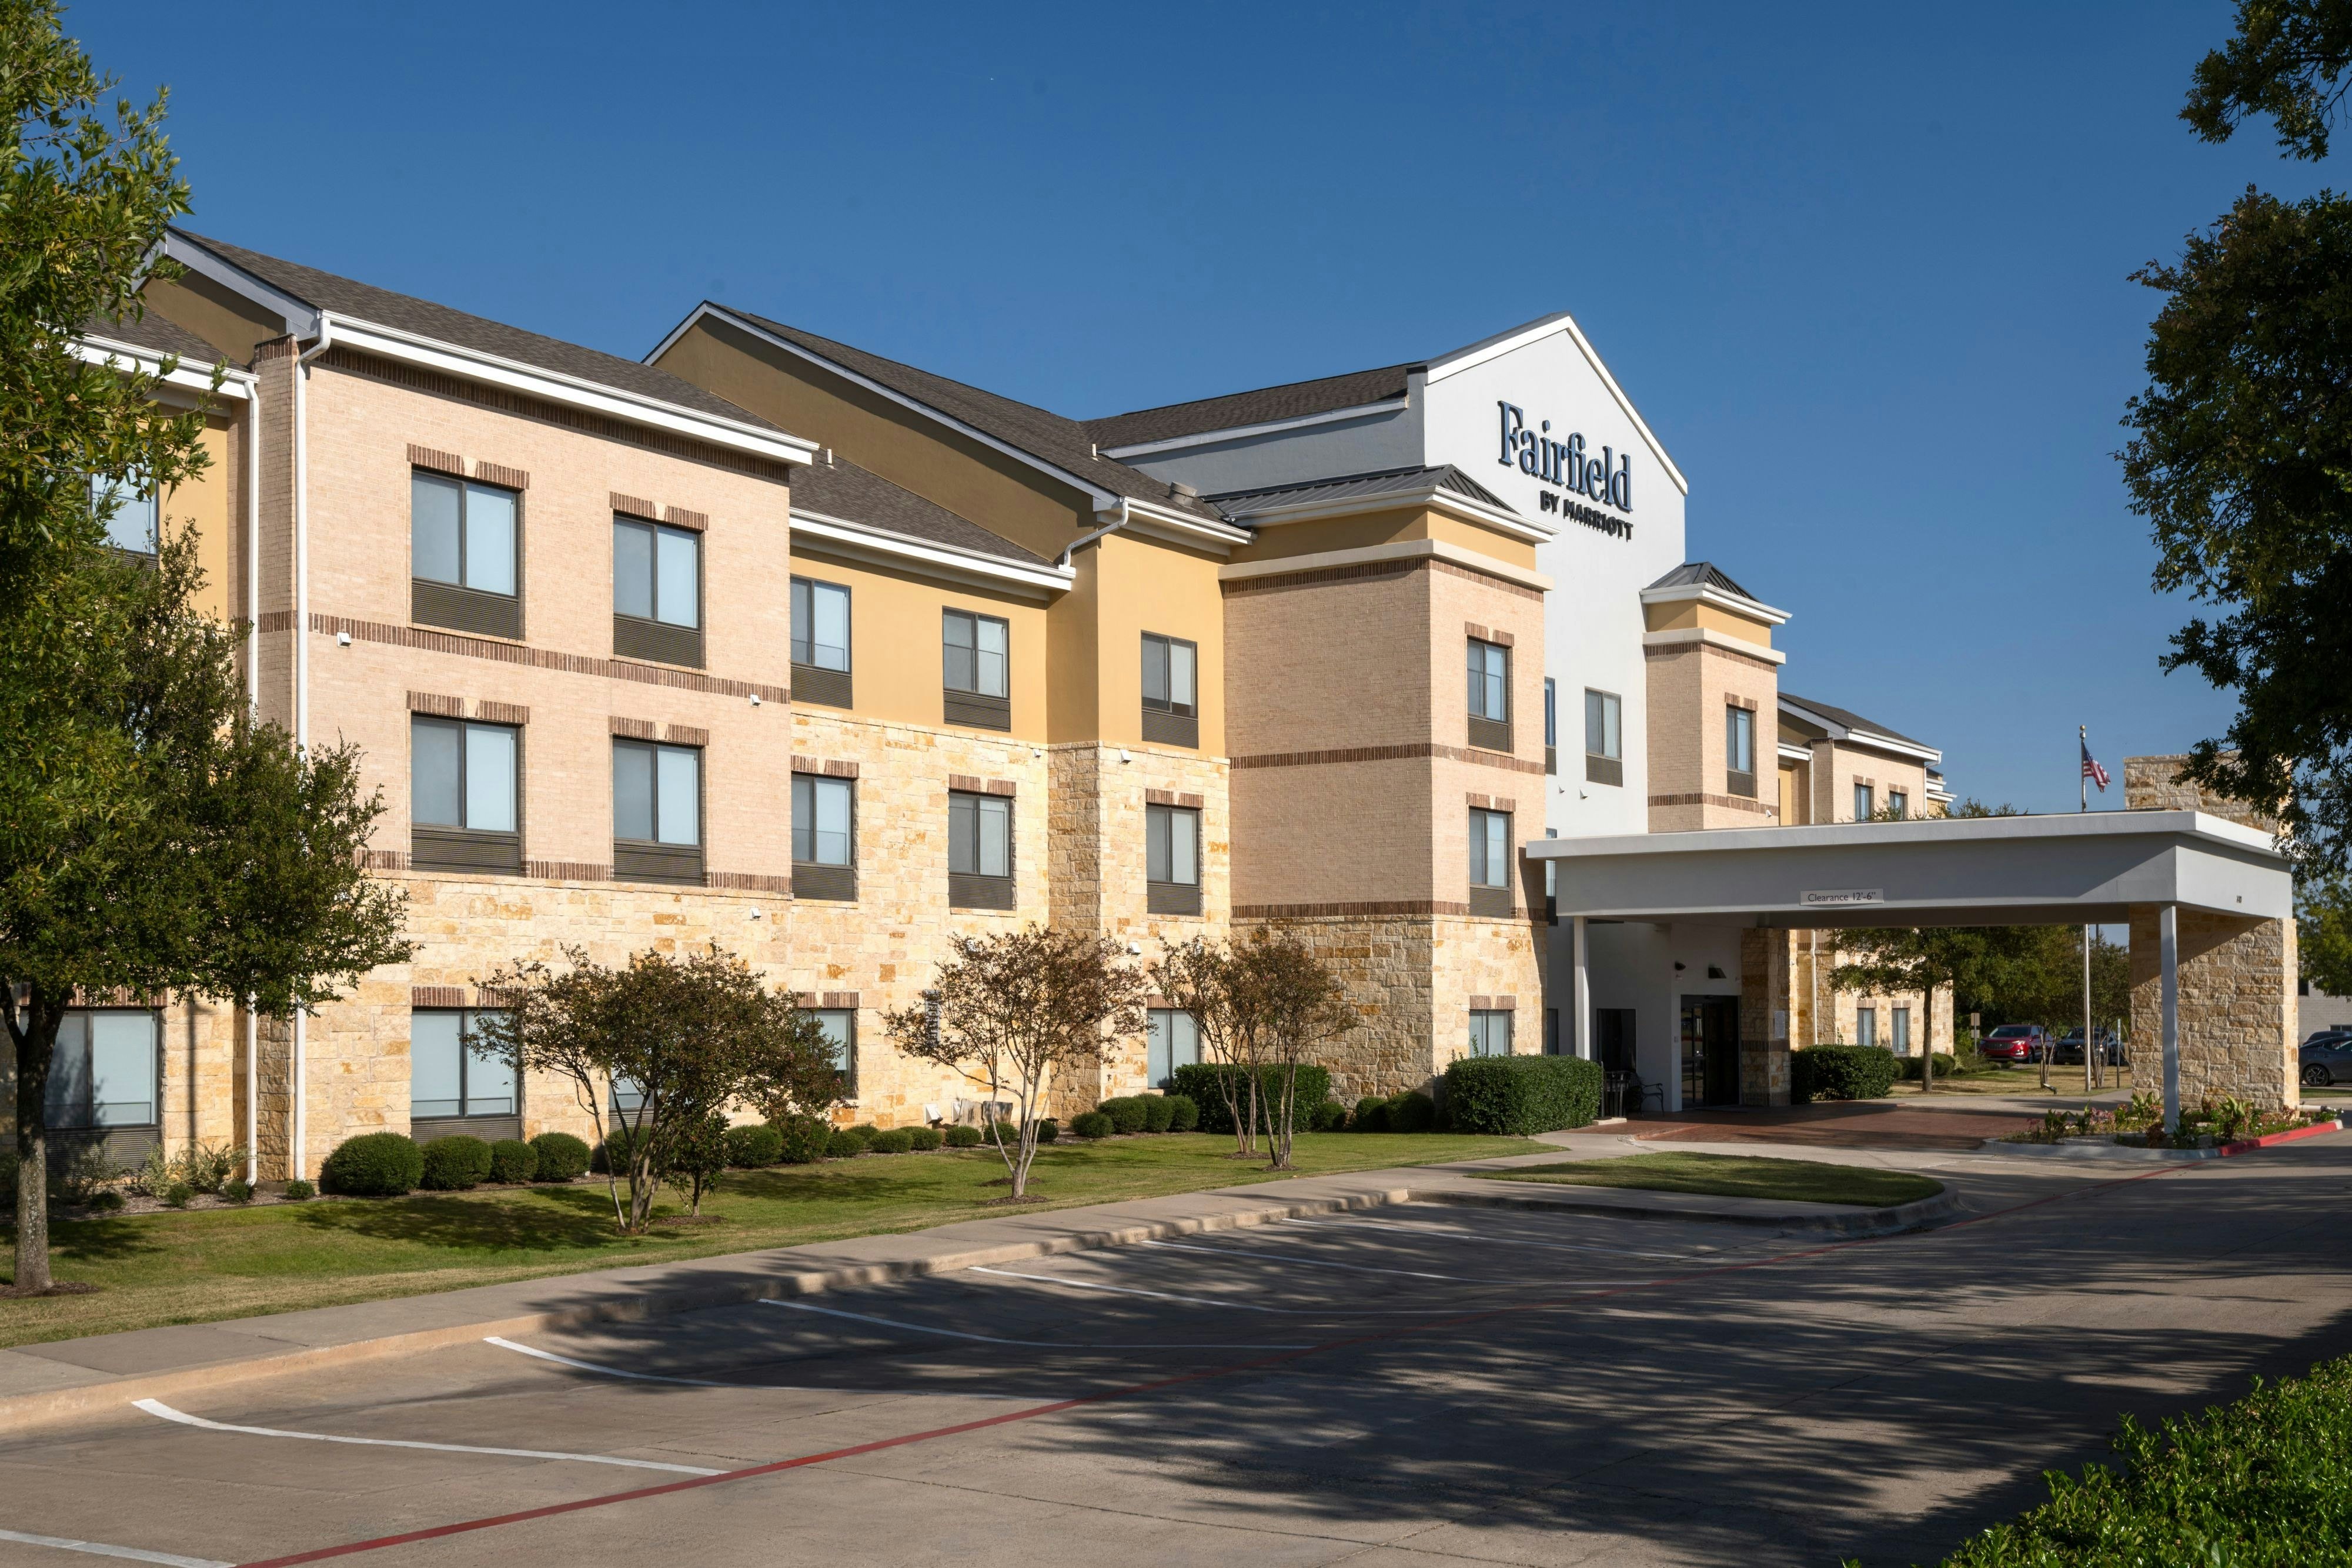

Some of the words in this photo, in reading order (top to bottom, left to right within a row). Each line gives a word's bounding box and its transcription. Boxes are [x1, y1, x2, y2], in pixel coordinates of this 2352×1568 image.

[1497, 400, 1633, 514] Fairfield
[1540, 490, 1560, 514] BY
[1563, 499, 1633, 542] MARRIOTT
[1808, 894, 1849, 902] Clearance
